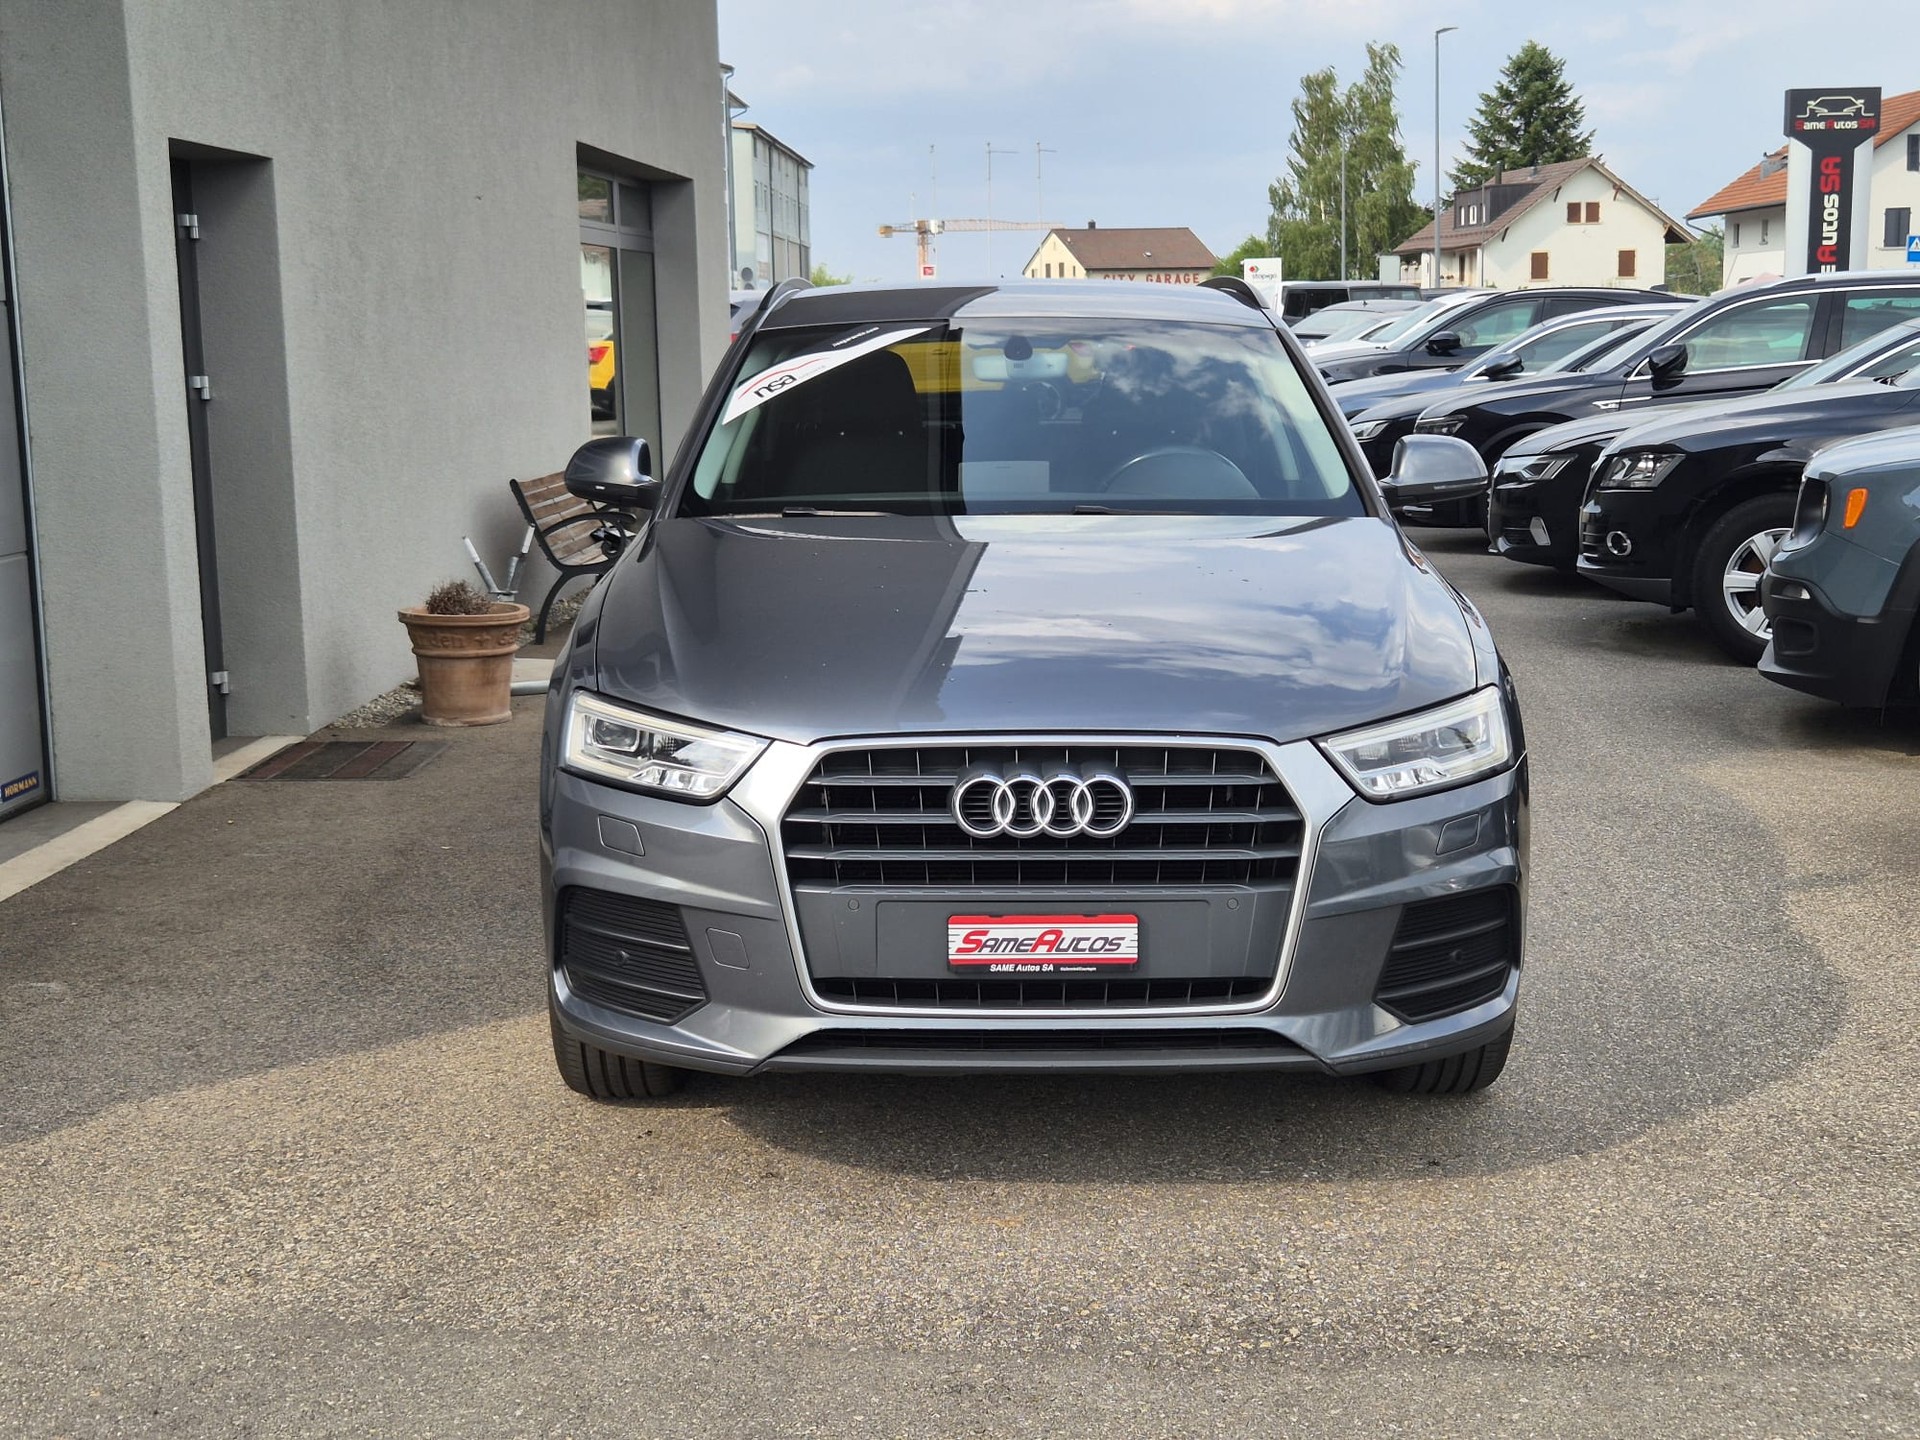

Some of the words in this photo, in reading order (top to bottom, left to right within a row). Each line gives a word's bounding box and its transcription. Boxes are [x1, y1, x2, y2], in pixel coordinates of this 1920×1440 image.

[1145, 272, 1200, 284] GARAGE
[753, 374, 798, 399] nsa
[989, 964, 1015, 973] SAME
[1015, 964, 1041, 973] Autos
[1041, 964, 1054, 972] SA
